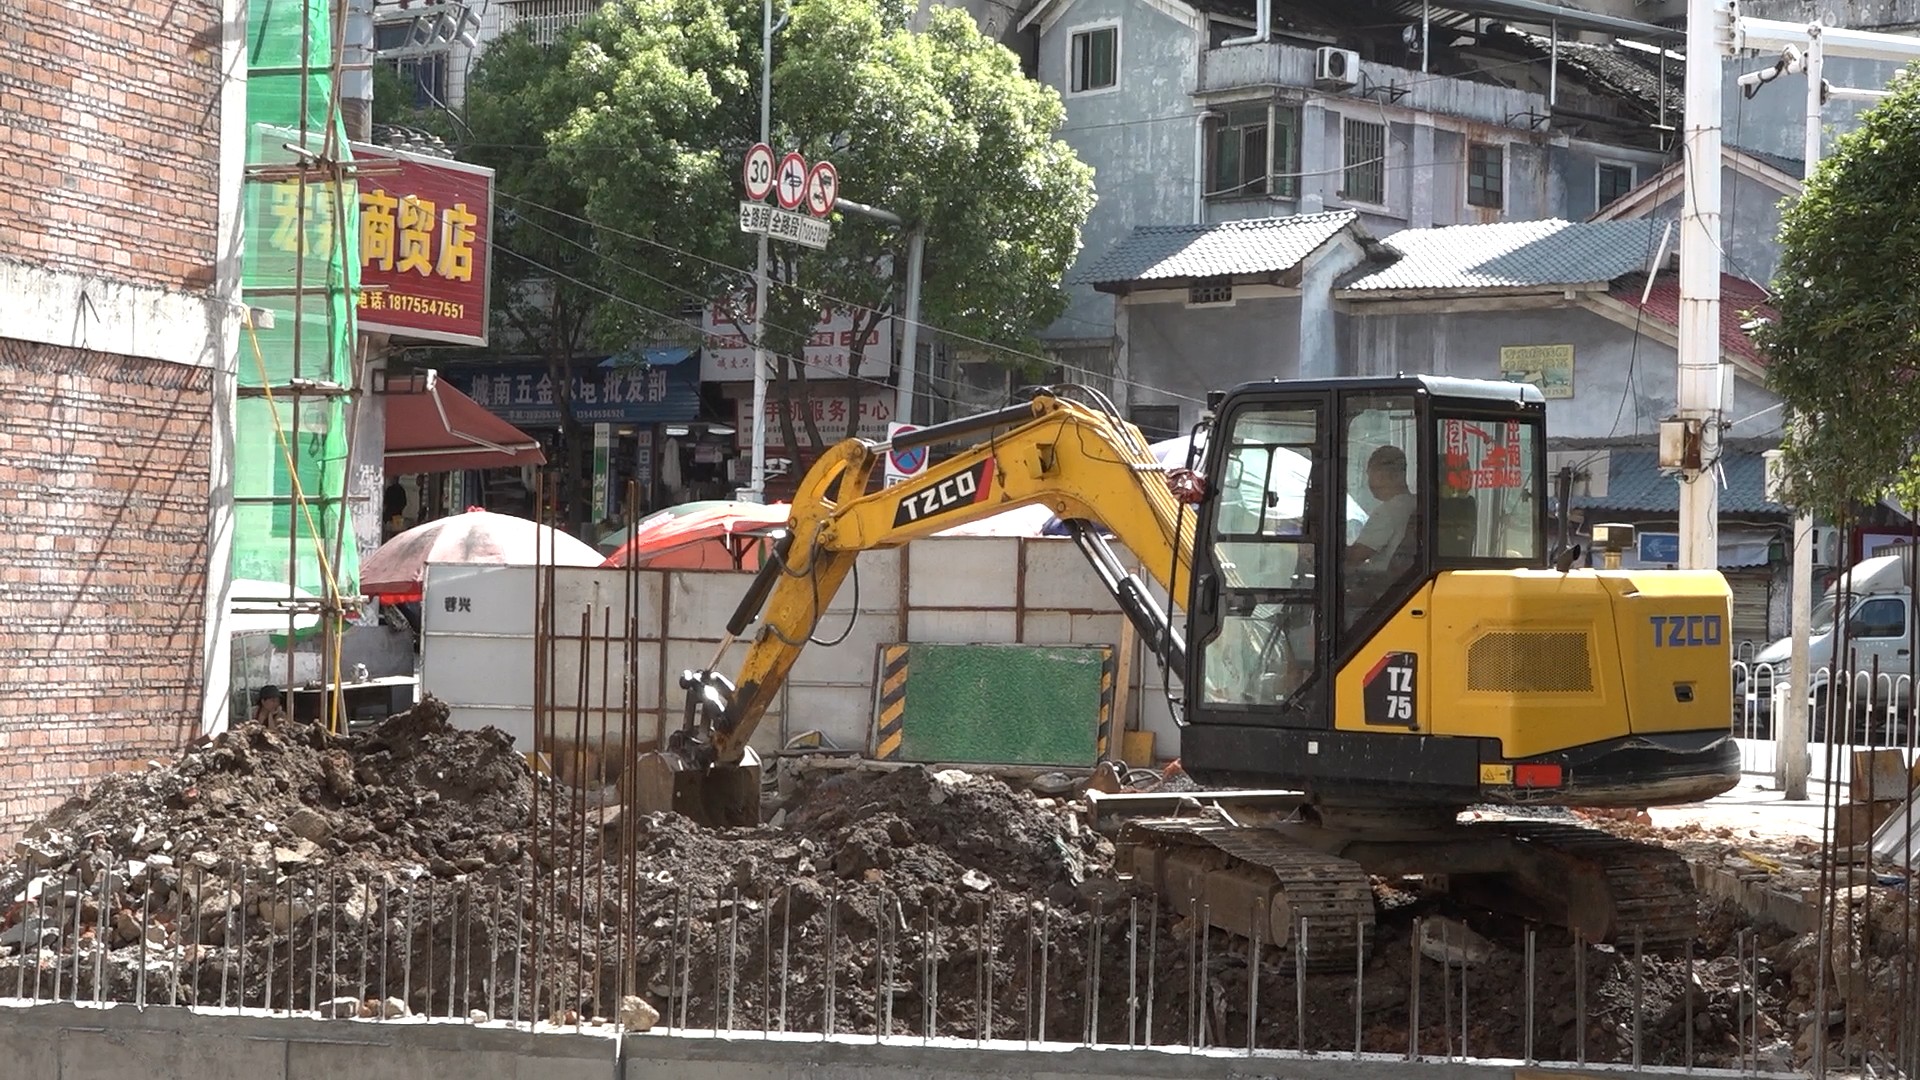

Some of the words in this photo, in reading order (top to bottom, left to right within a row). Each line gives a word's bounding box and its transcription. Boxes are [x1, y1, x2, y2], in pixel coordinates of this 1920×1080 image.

[751, 160, 768, 183] 30
[741, 205, 770, 228] 全路段
[771, 212, 799, 238] 全路段
[902, 471, 976, 521] TZCO
[1650, 615, 1721, 648] TZCO
[1387, 667, 1413, 692] TZ
[1387, 695, 1412, 719] 75
